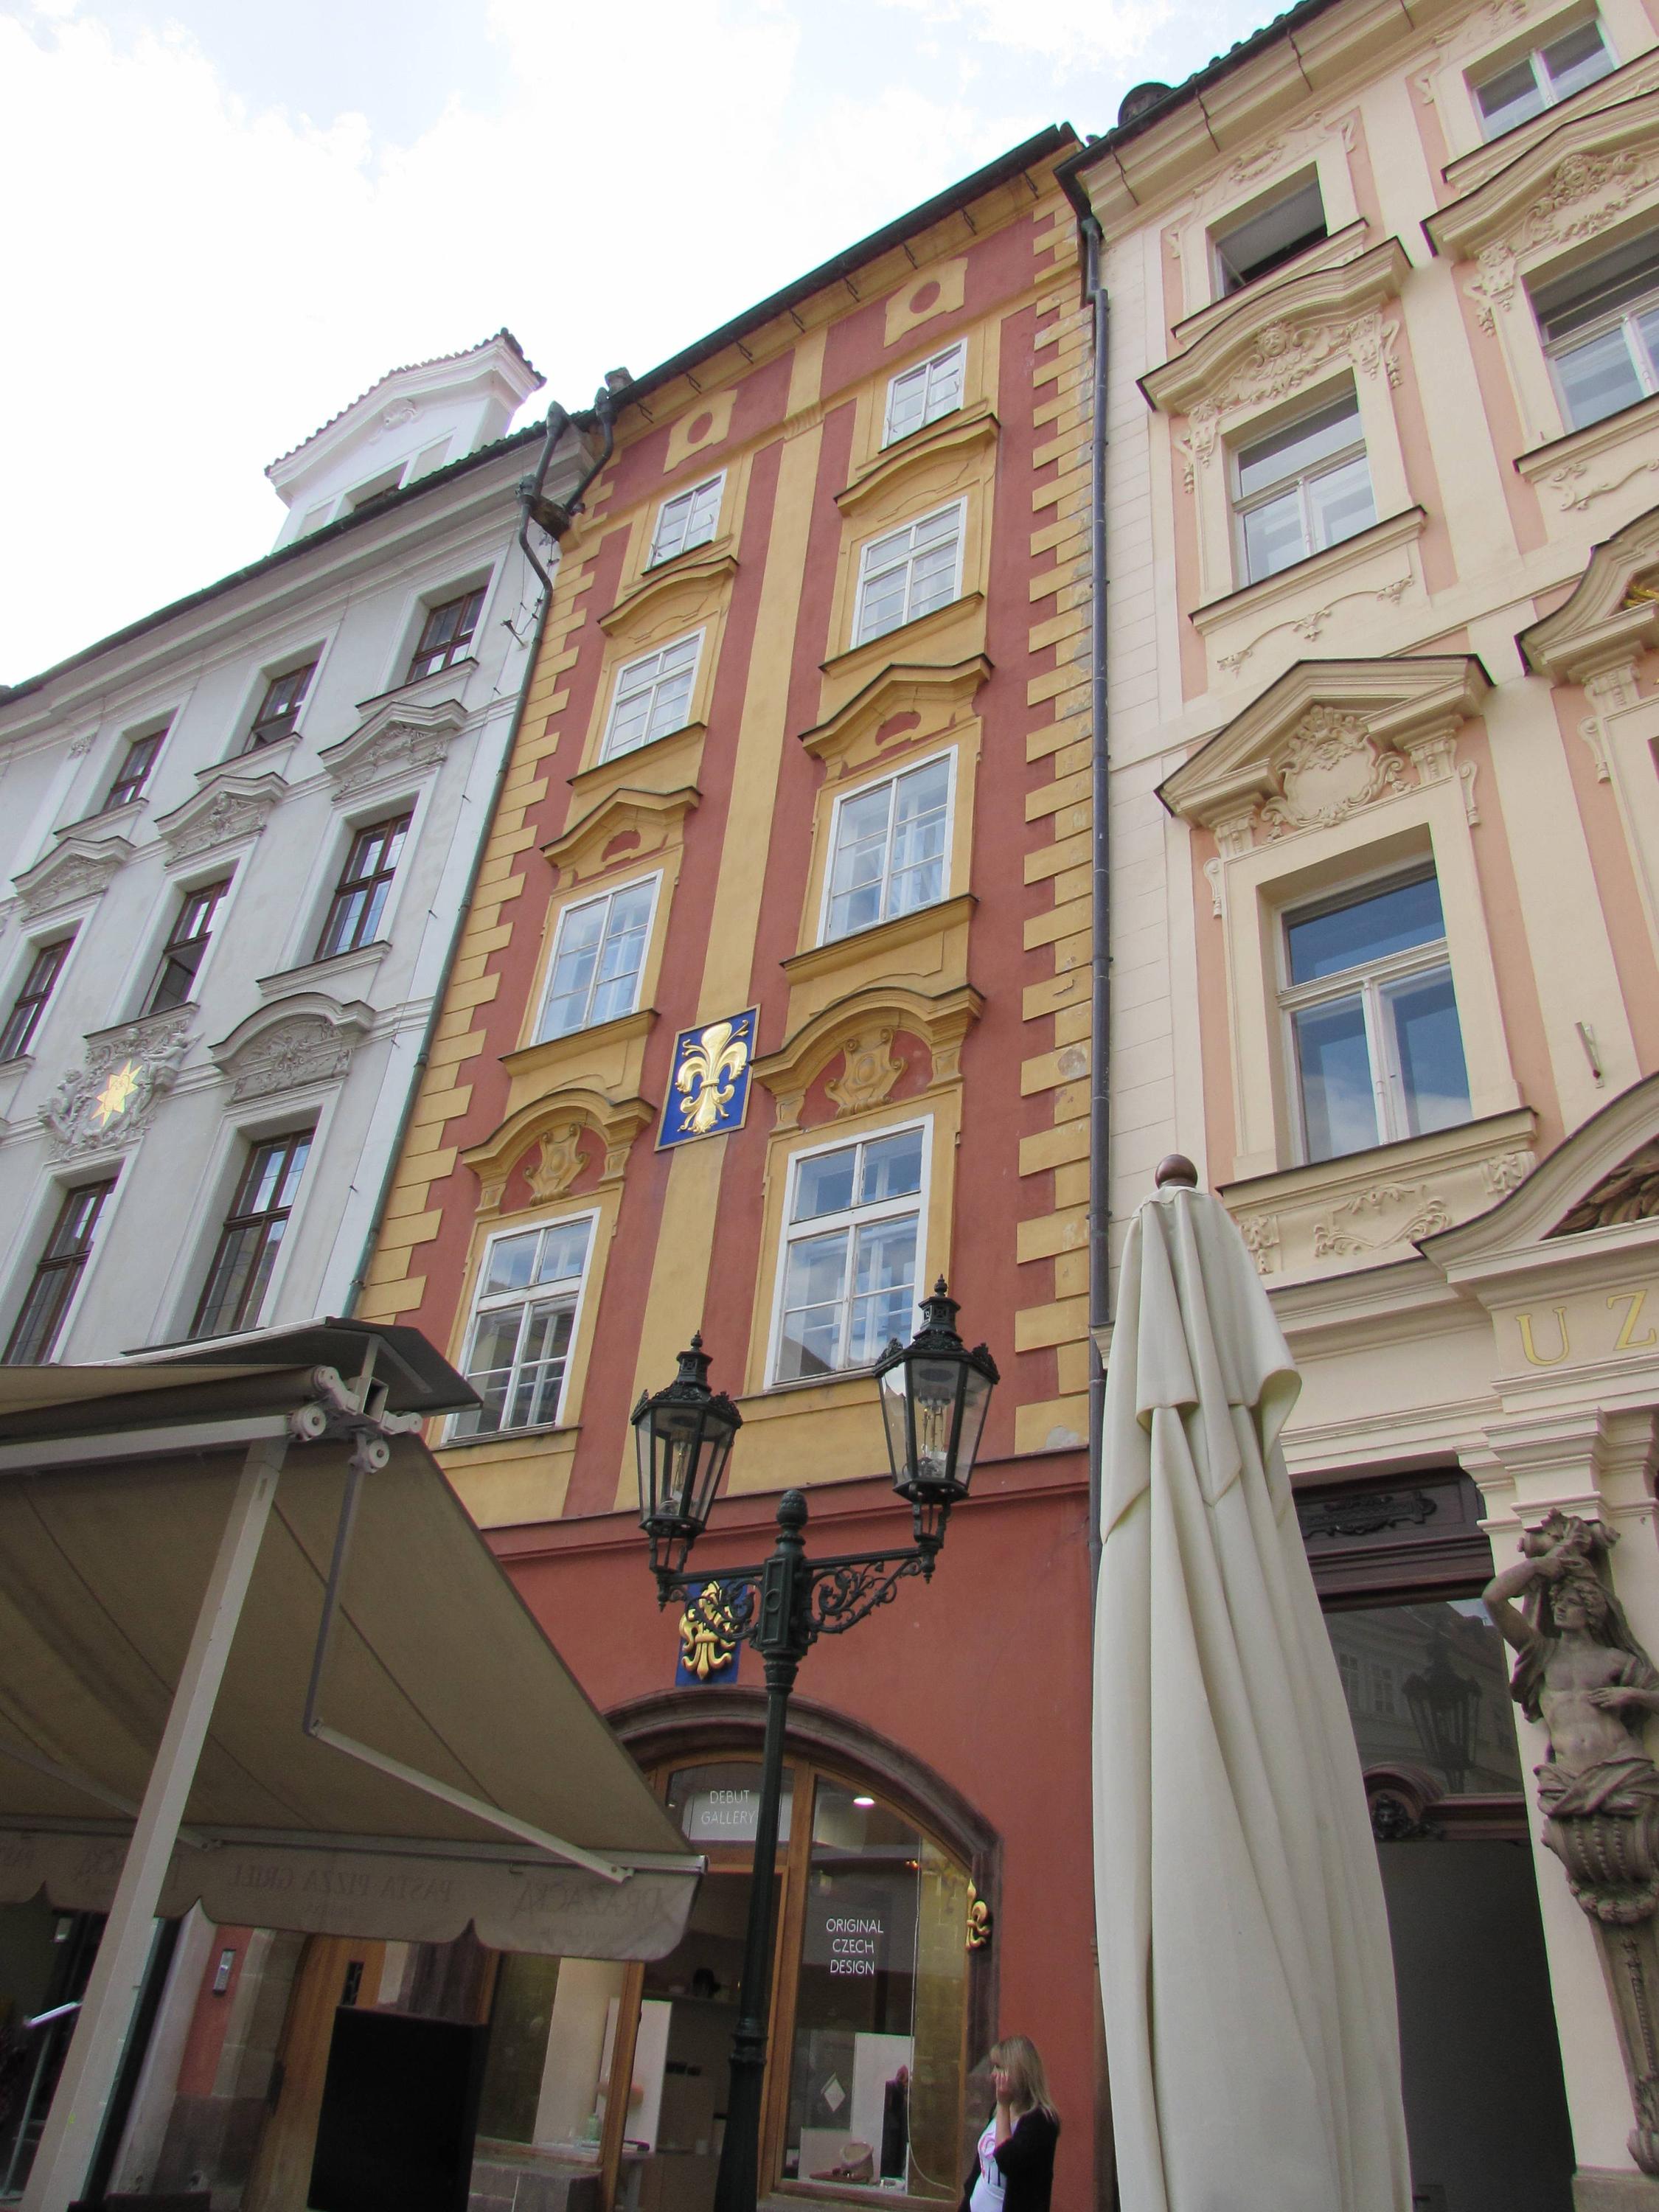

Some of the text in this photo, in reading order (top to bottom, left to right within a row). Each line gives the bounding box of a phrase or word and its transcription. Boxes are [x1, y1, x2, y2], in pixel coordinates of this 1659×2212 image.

[1516, 1307, 1569, 1366] U
[710, 1790, 750, 1804] DEBUT
[701, 1810, 757, 1825] GALLERY
[826, 1919, 884, 1933] ORIGINAL
[832, 1938, 874, 1953] CZECH
[830, 1959, 874, 1975] DESIGN
